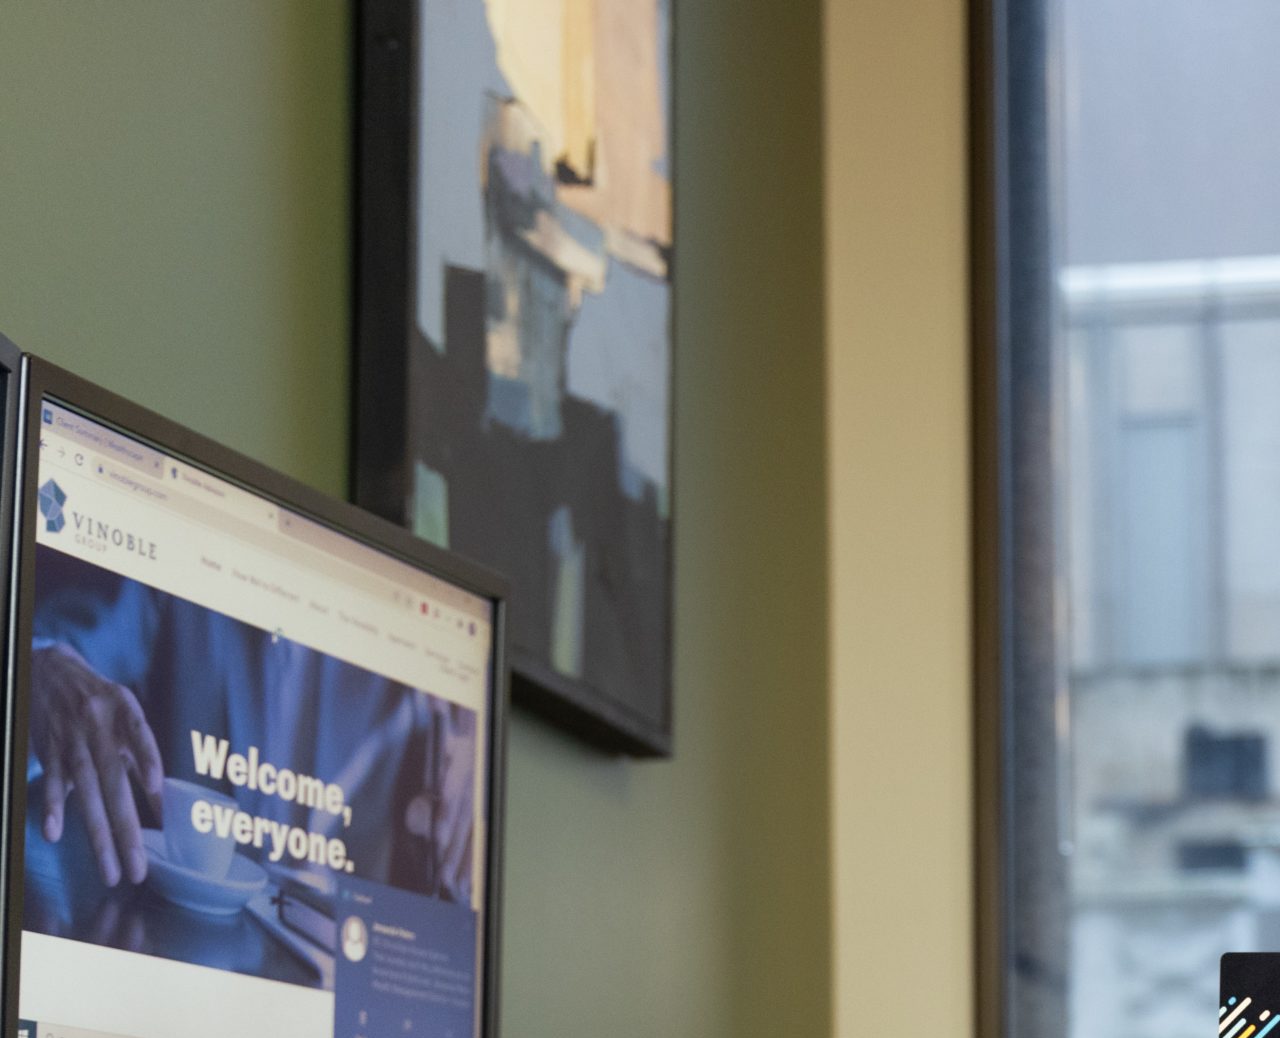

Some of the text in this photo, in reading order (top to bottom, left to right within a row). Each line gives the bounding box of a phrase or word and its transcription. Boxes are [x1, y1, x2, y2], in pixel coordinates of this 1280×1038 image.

[73, 511, 157, 560] VINOBLE
[191, 730, 353, 827] Welcome,
[191, 800, 354, 873] everyone.
